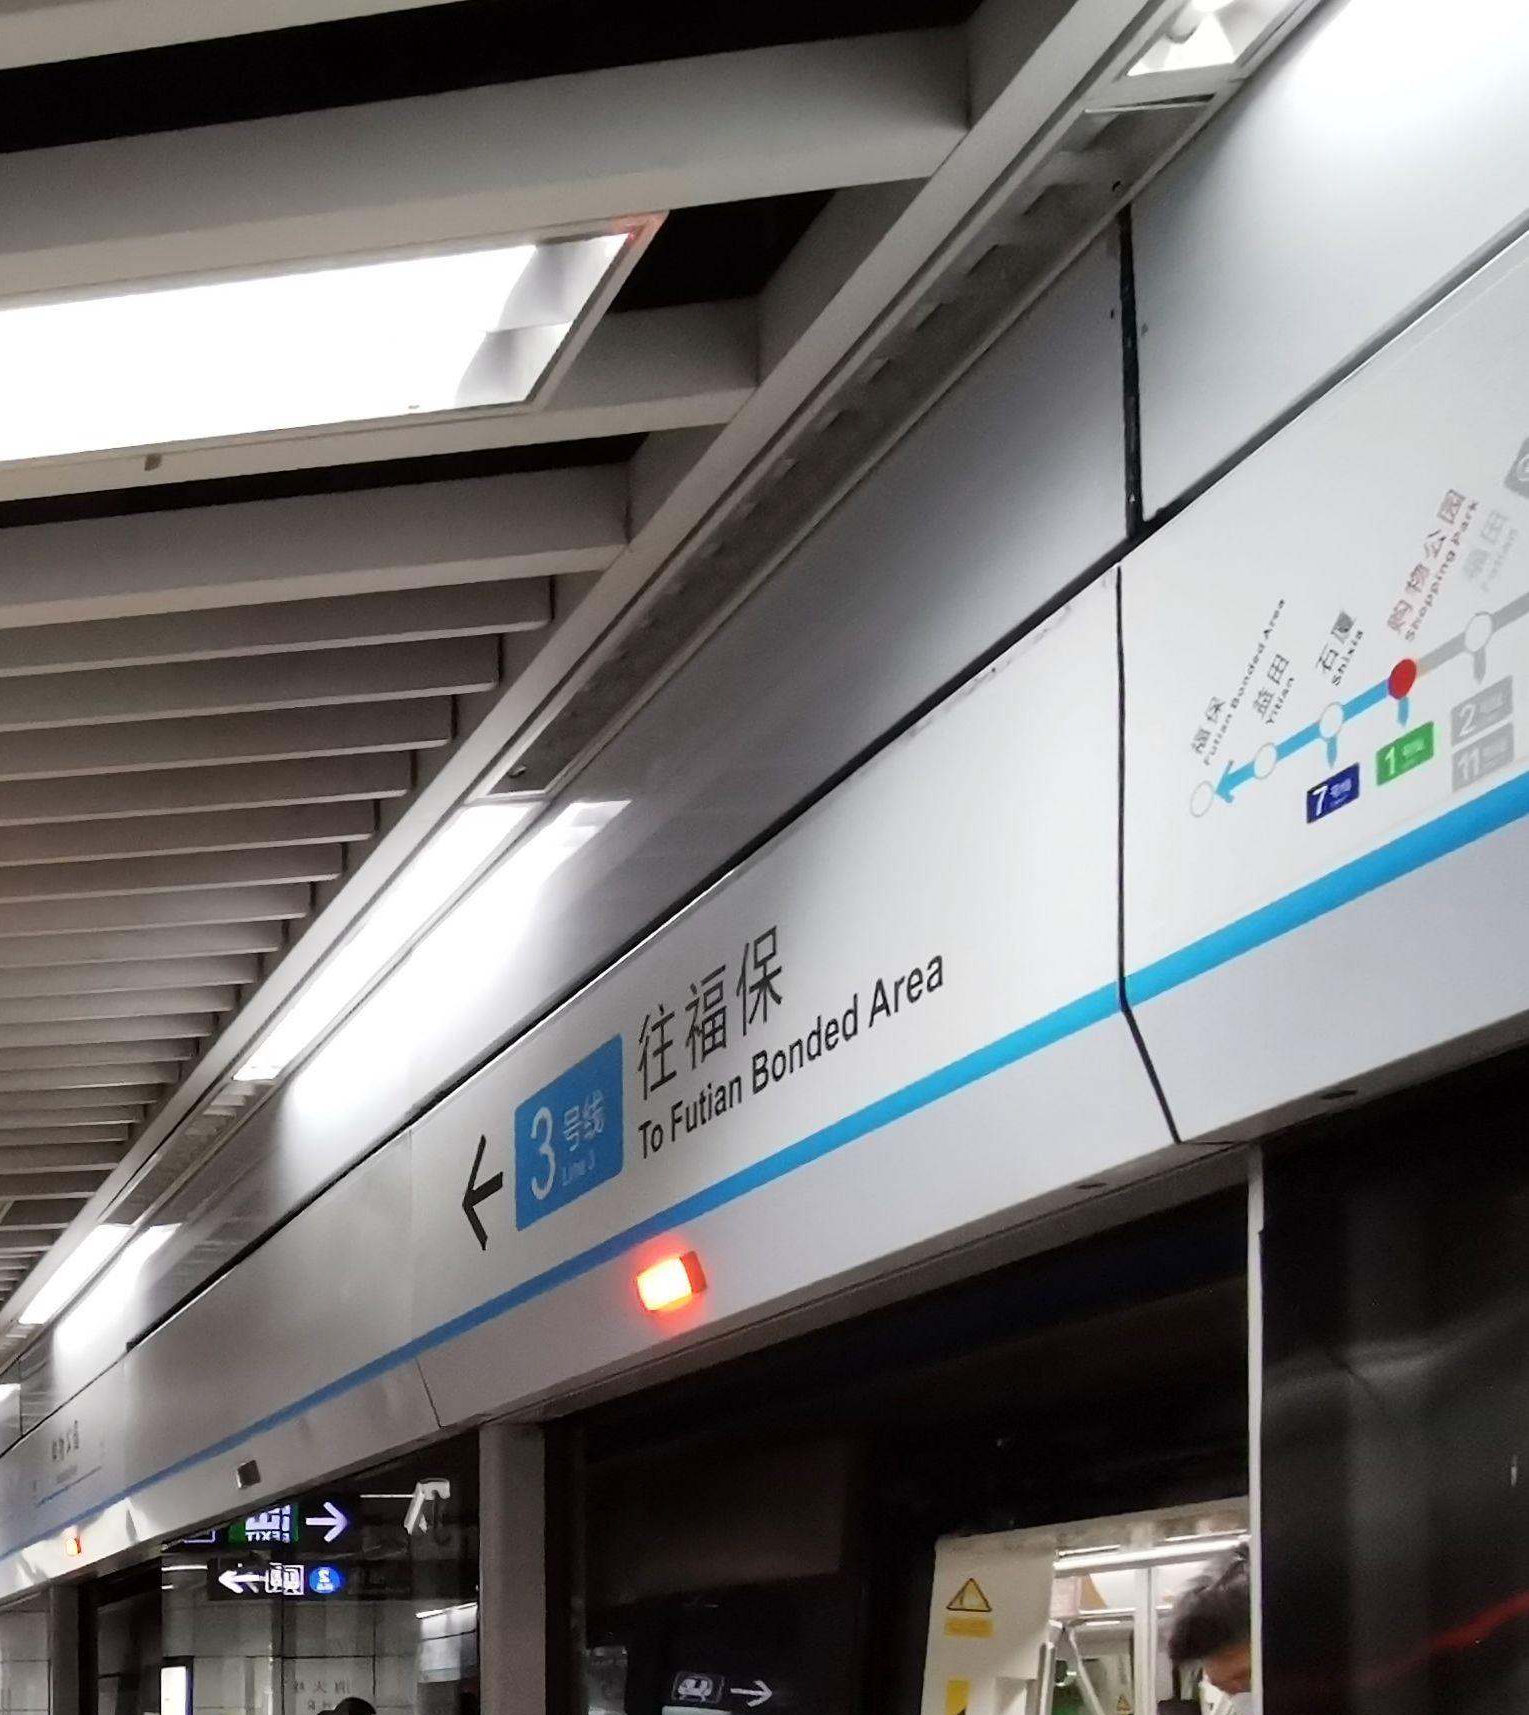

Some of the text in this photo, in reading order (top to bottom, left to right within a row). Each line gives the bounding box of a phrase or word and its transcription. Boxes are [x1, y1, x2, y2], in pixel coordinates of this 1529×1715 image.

[638, 926, 782, 1100] 往福保
[638, 955, 943, 1158] To Futian Bonded Area
